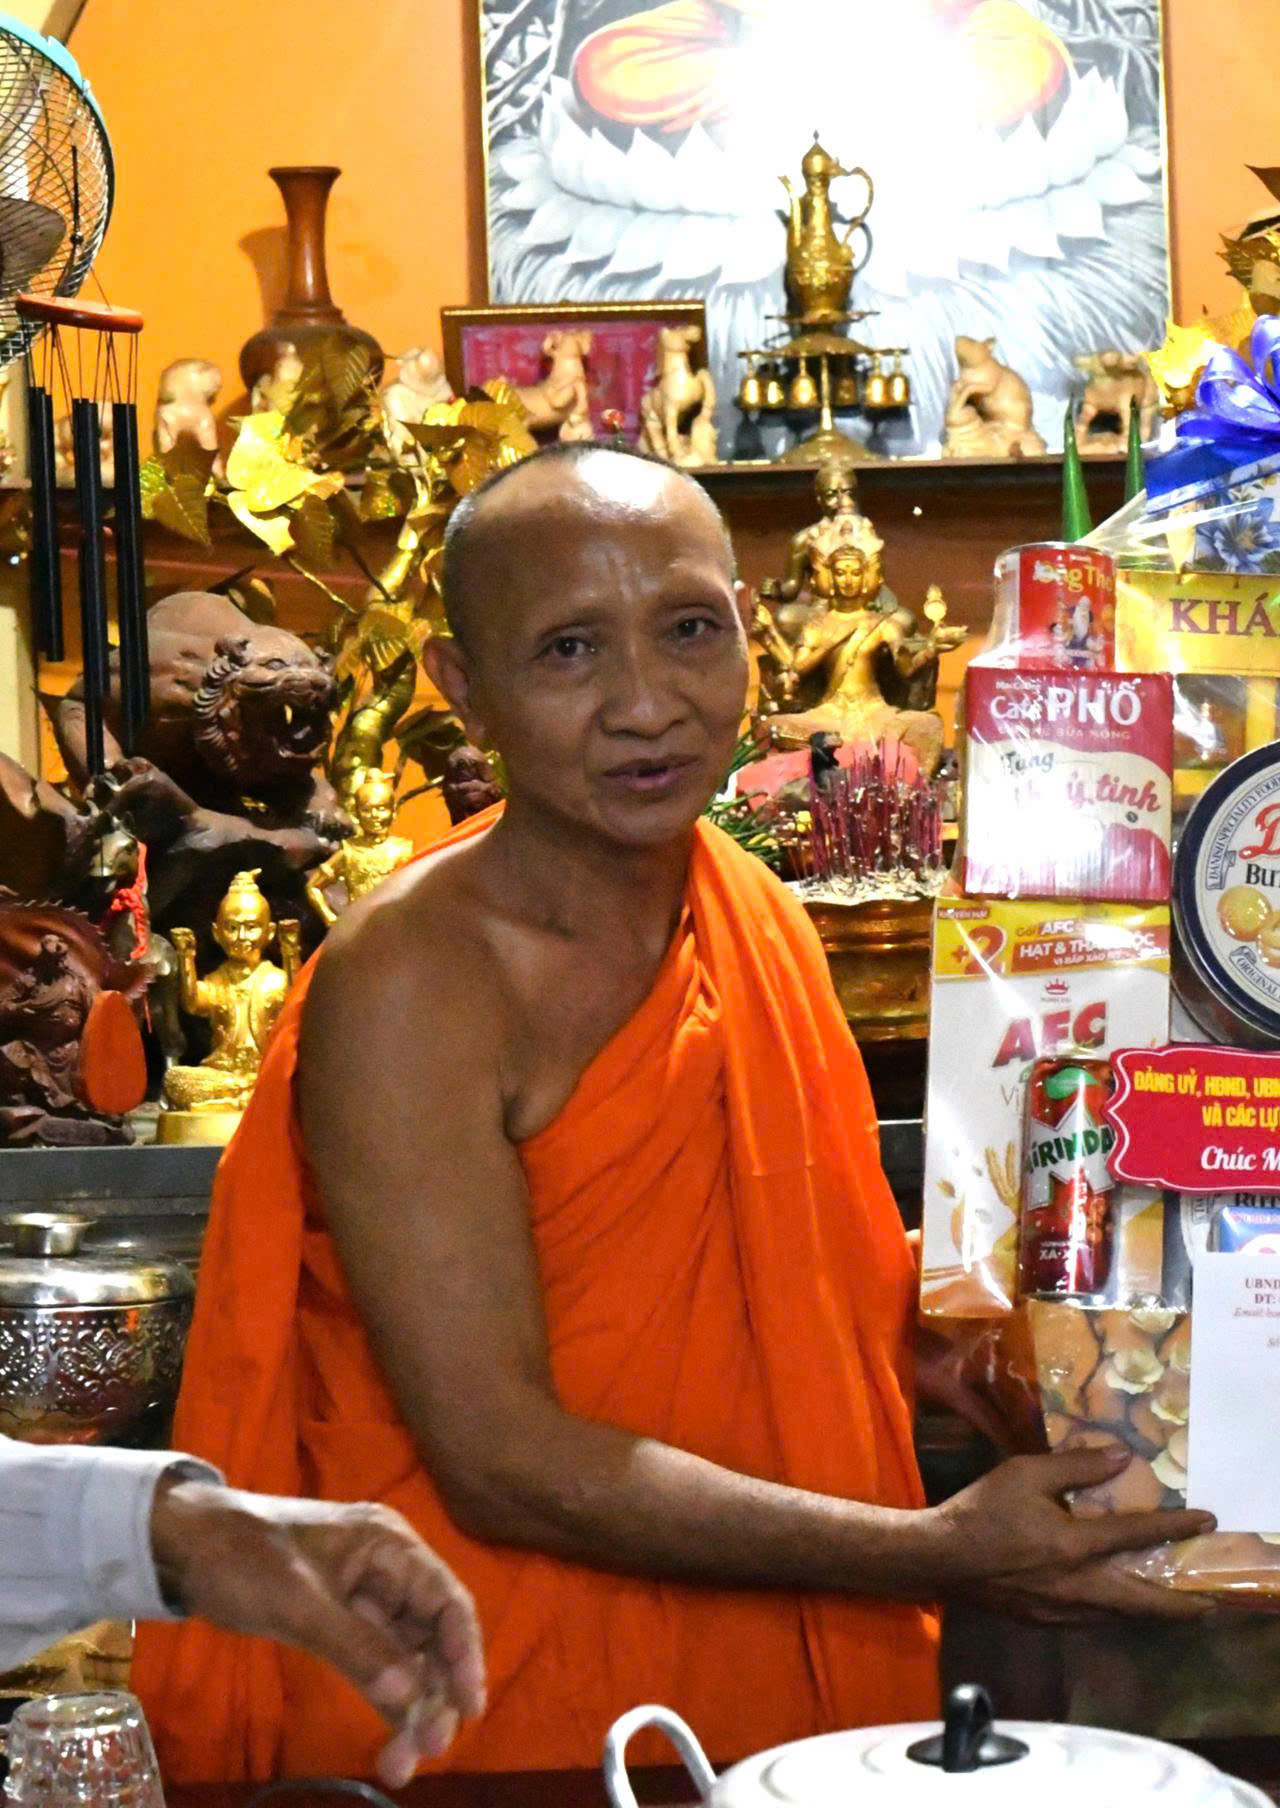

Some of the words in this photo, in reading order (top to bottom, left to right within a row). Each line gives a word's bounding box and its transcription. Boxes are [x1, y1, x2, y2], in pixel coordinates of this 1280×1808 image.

[1095, 773, 1161, 813] tinh
[1040, 919, 1075, 936] AFC
[1019, 942, 1054, 961] HẠT
[1054, 941, 1066, 954] &
[991, 1001, 1106, 1068] AFC
[1133, 1065, 1175, 1094] ĐẢNG
[1202, 1101, 1224, 1127] VÀ
[1225, 1102, 1256, 1127] CÁC
[1200, 1145, 1257, 1171] Chúc
[1254, 1293, 1277, 1306] ĐT:
